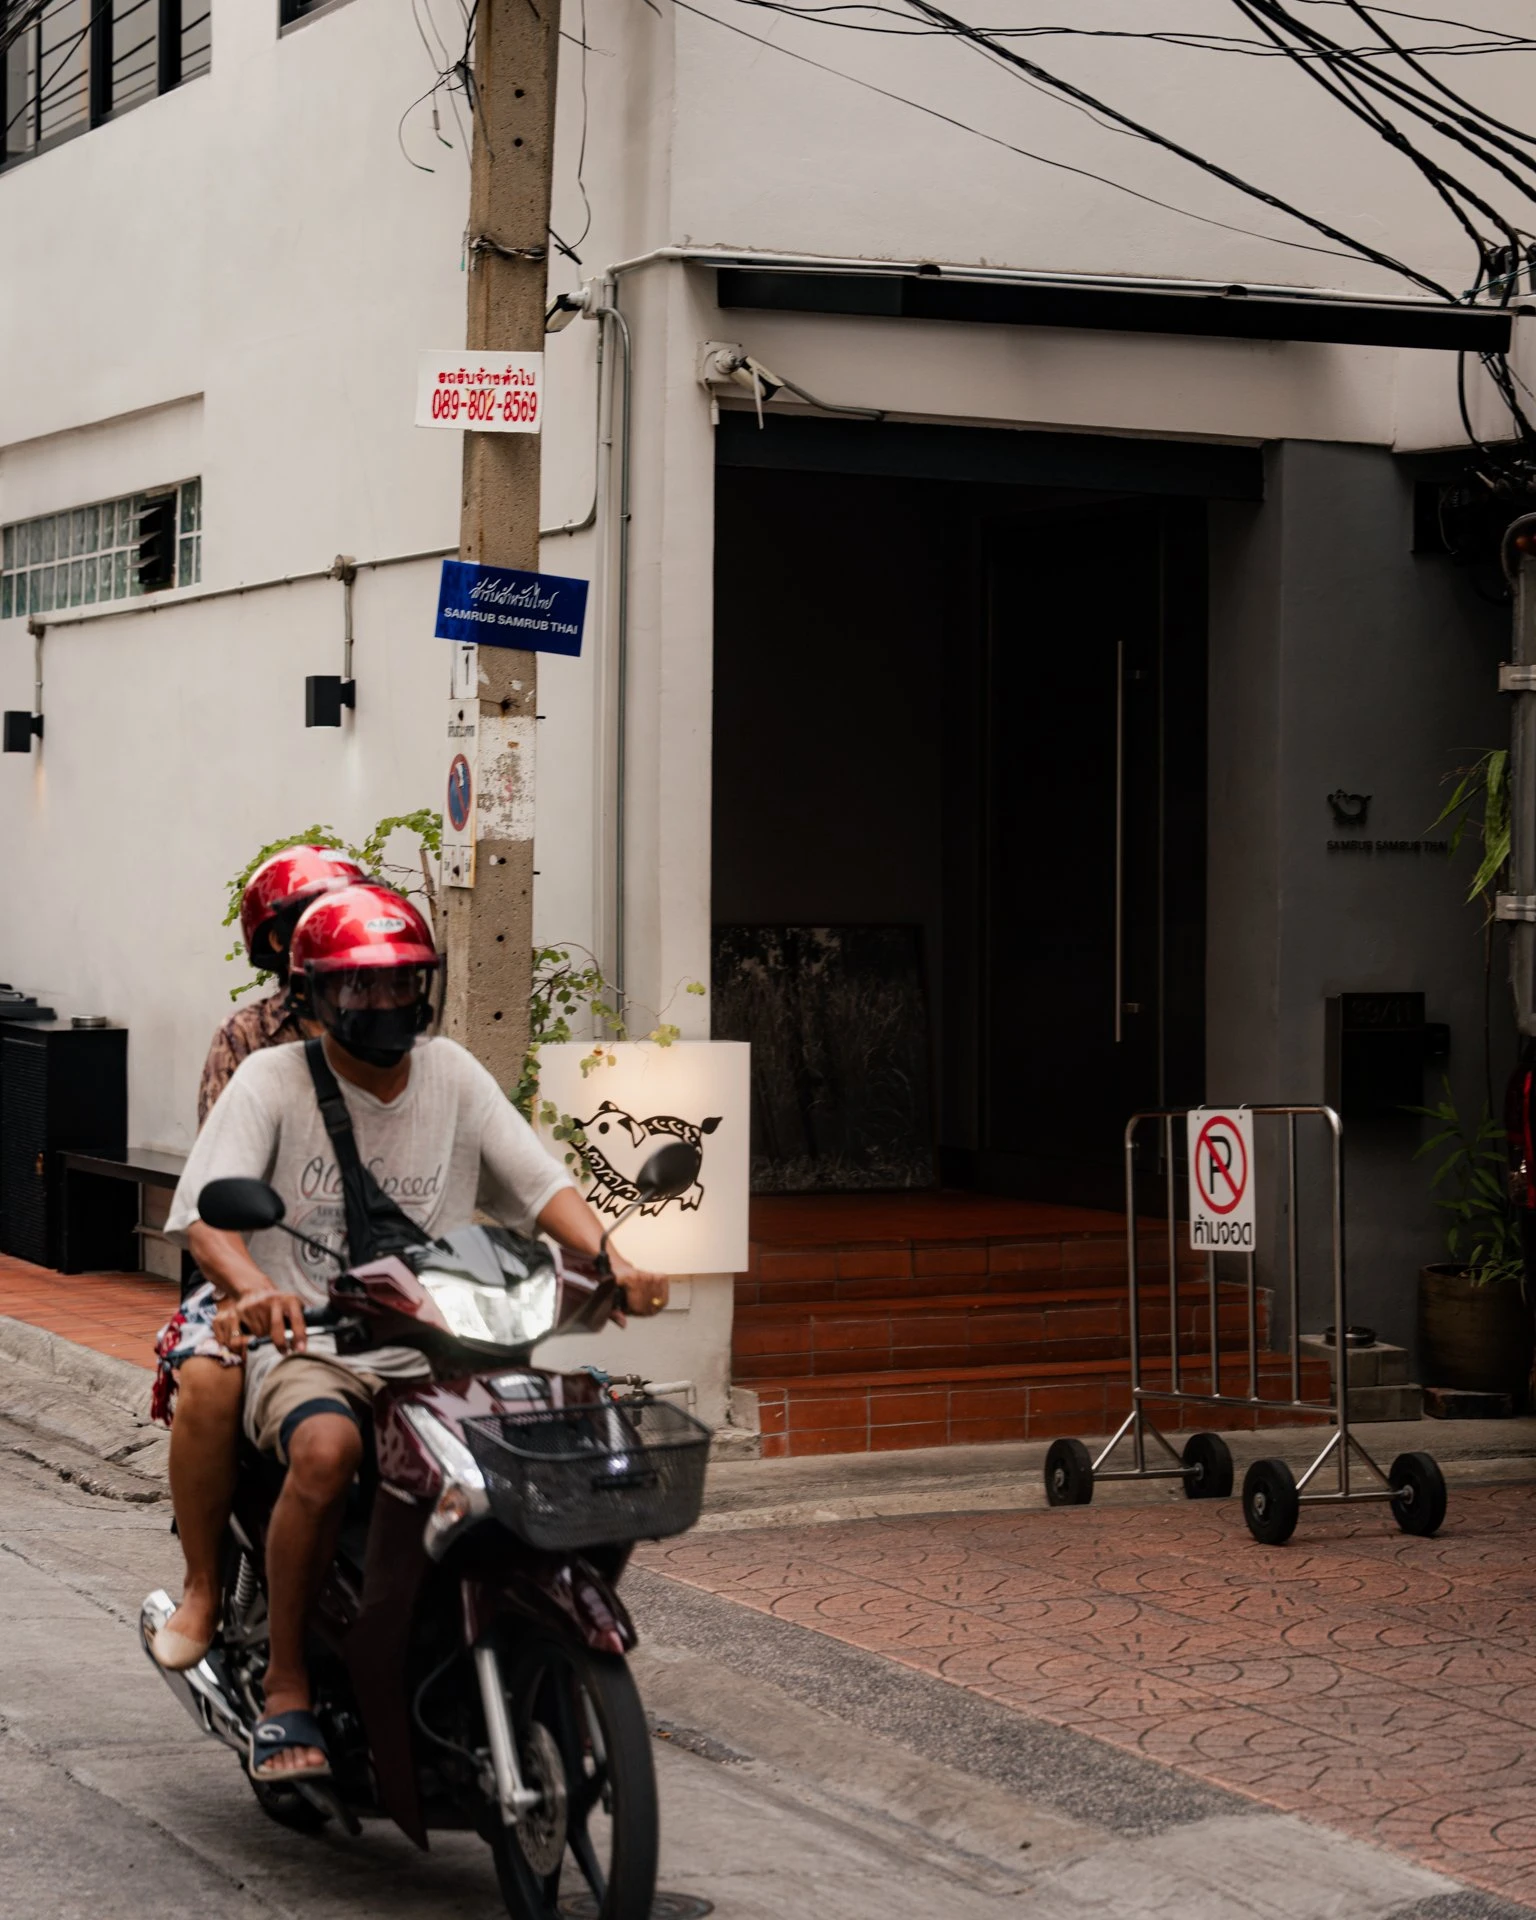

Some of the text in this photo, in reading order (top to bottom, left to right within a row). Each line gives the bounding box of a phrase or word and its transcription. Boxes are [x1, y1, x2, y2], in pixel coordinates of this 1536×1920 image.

[438, 365, 535, 386] รถรับจ้างทั่วไป
[432, 389, 537, 422] 089-802-8569
[444, 607, 578, 635] SAMRUB SAMRUB THAI
[1193, 1214, 1252, 1245] ห้ามจอด
